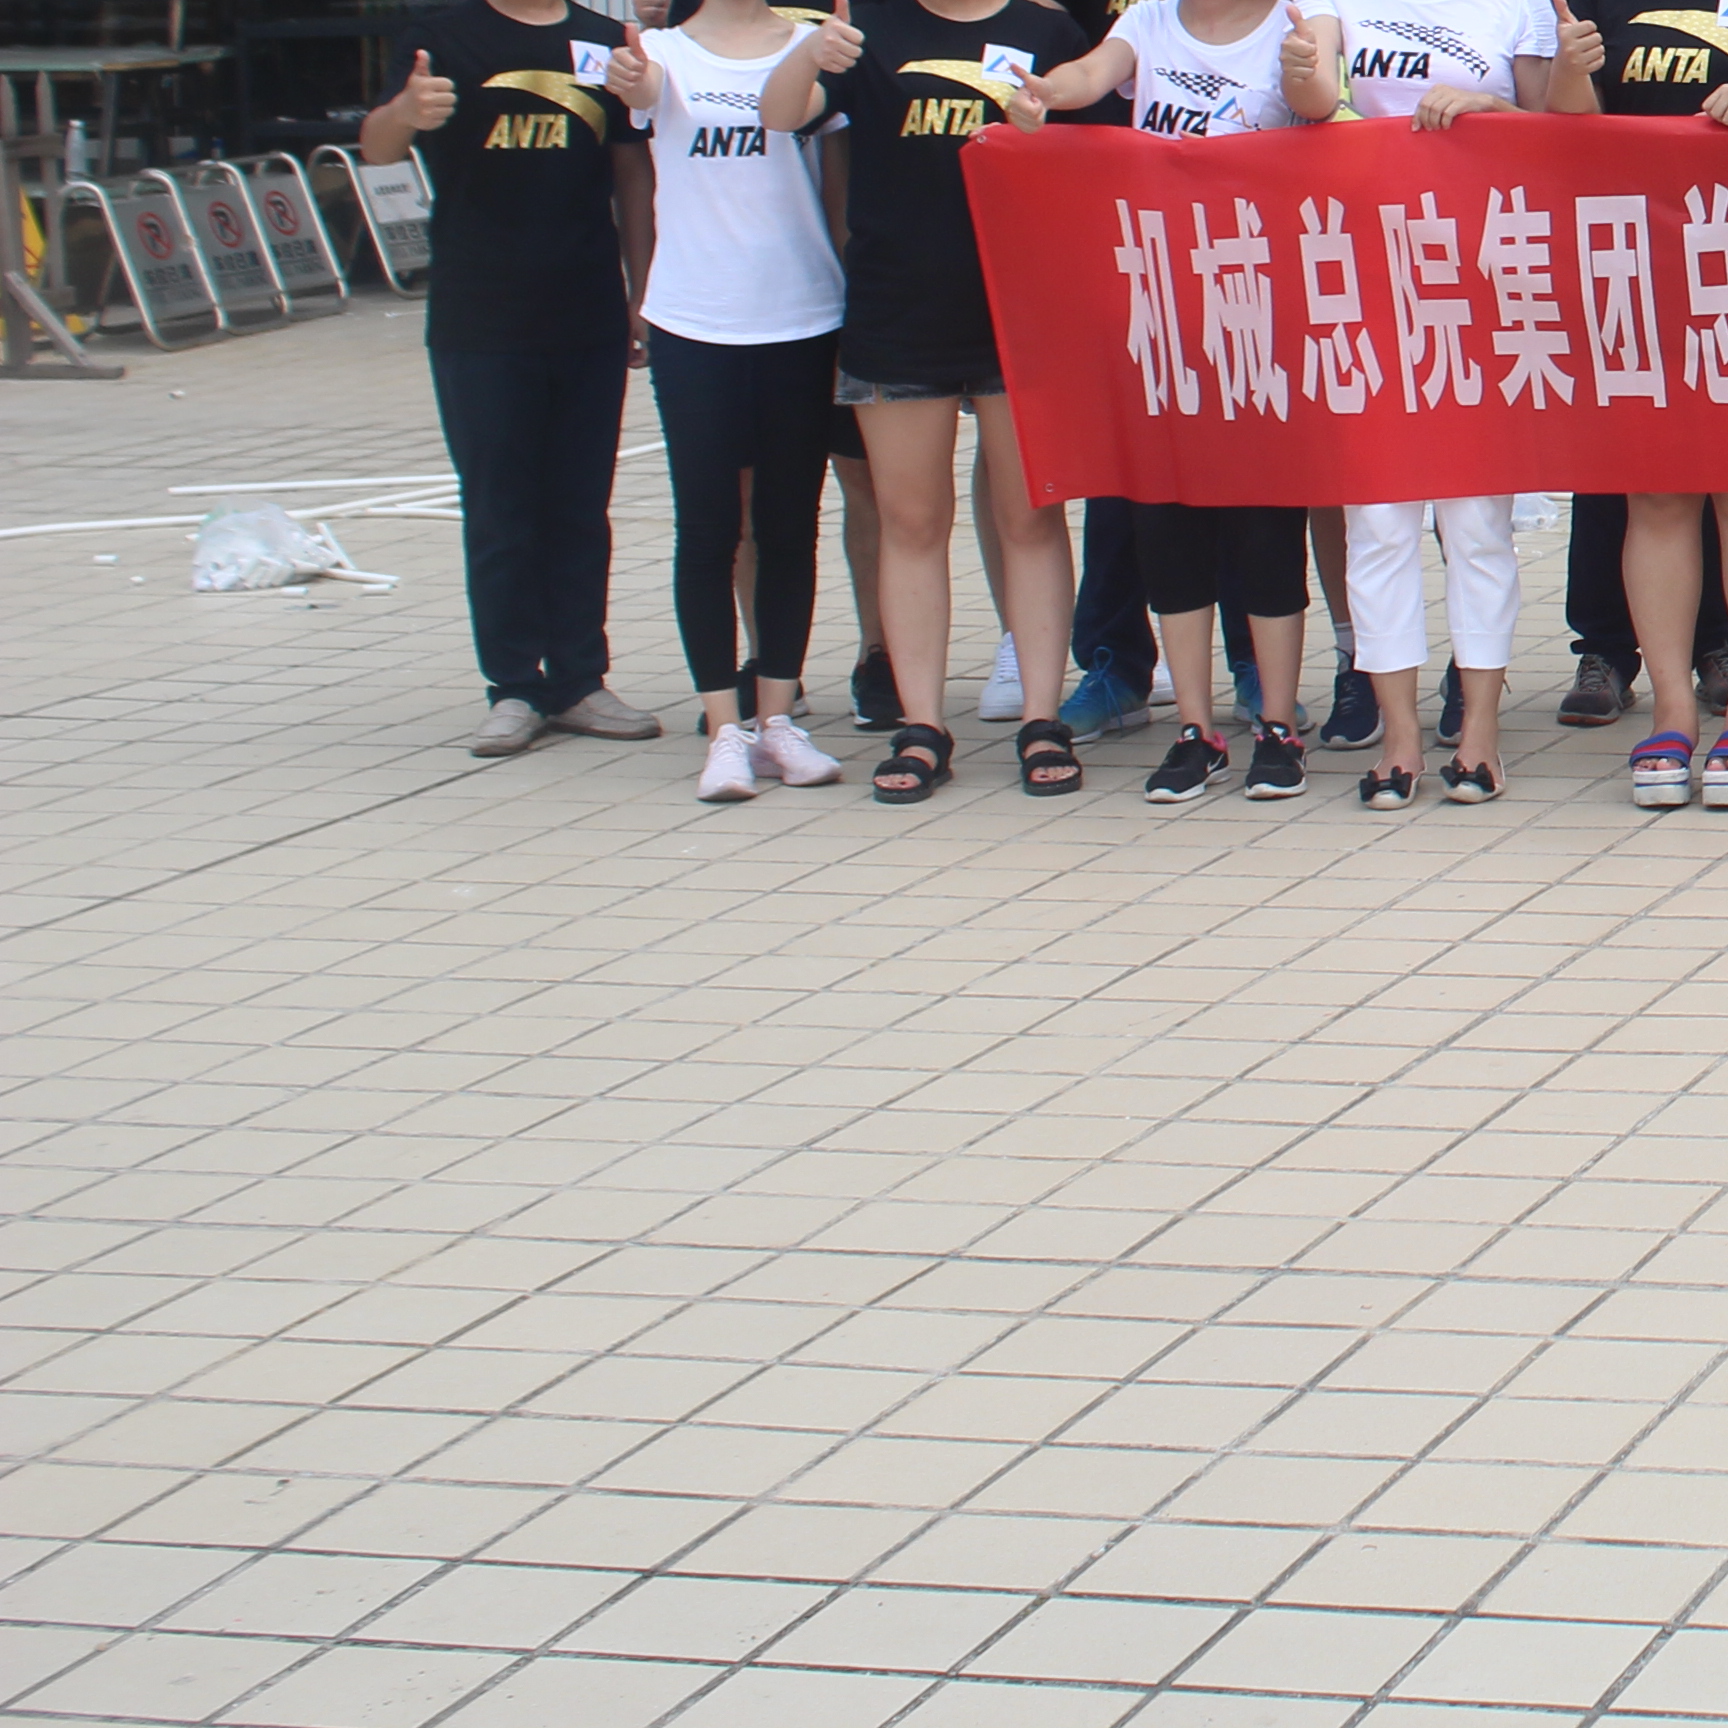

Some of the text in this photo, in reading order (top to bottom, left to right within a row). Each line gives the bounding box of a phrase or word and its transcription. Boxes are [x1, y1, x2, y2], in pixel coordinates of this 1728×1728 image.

[1350, 47, 1431, 79] ANTA
[1621, 46, 1711, 84] ANTA
[483, 113, 570, 149] ANTA
[900, 98, 985, 137] ANTA
[689, 125, 768, 158] ANTA
